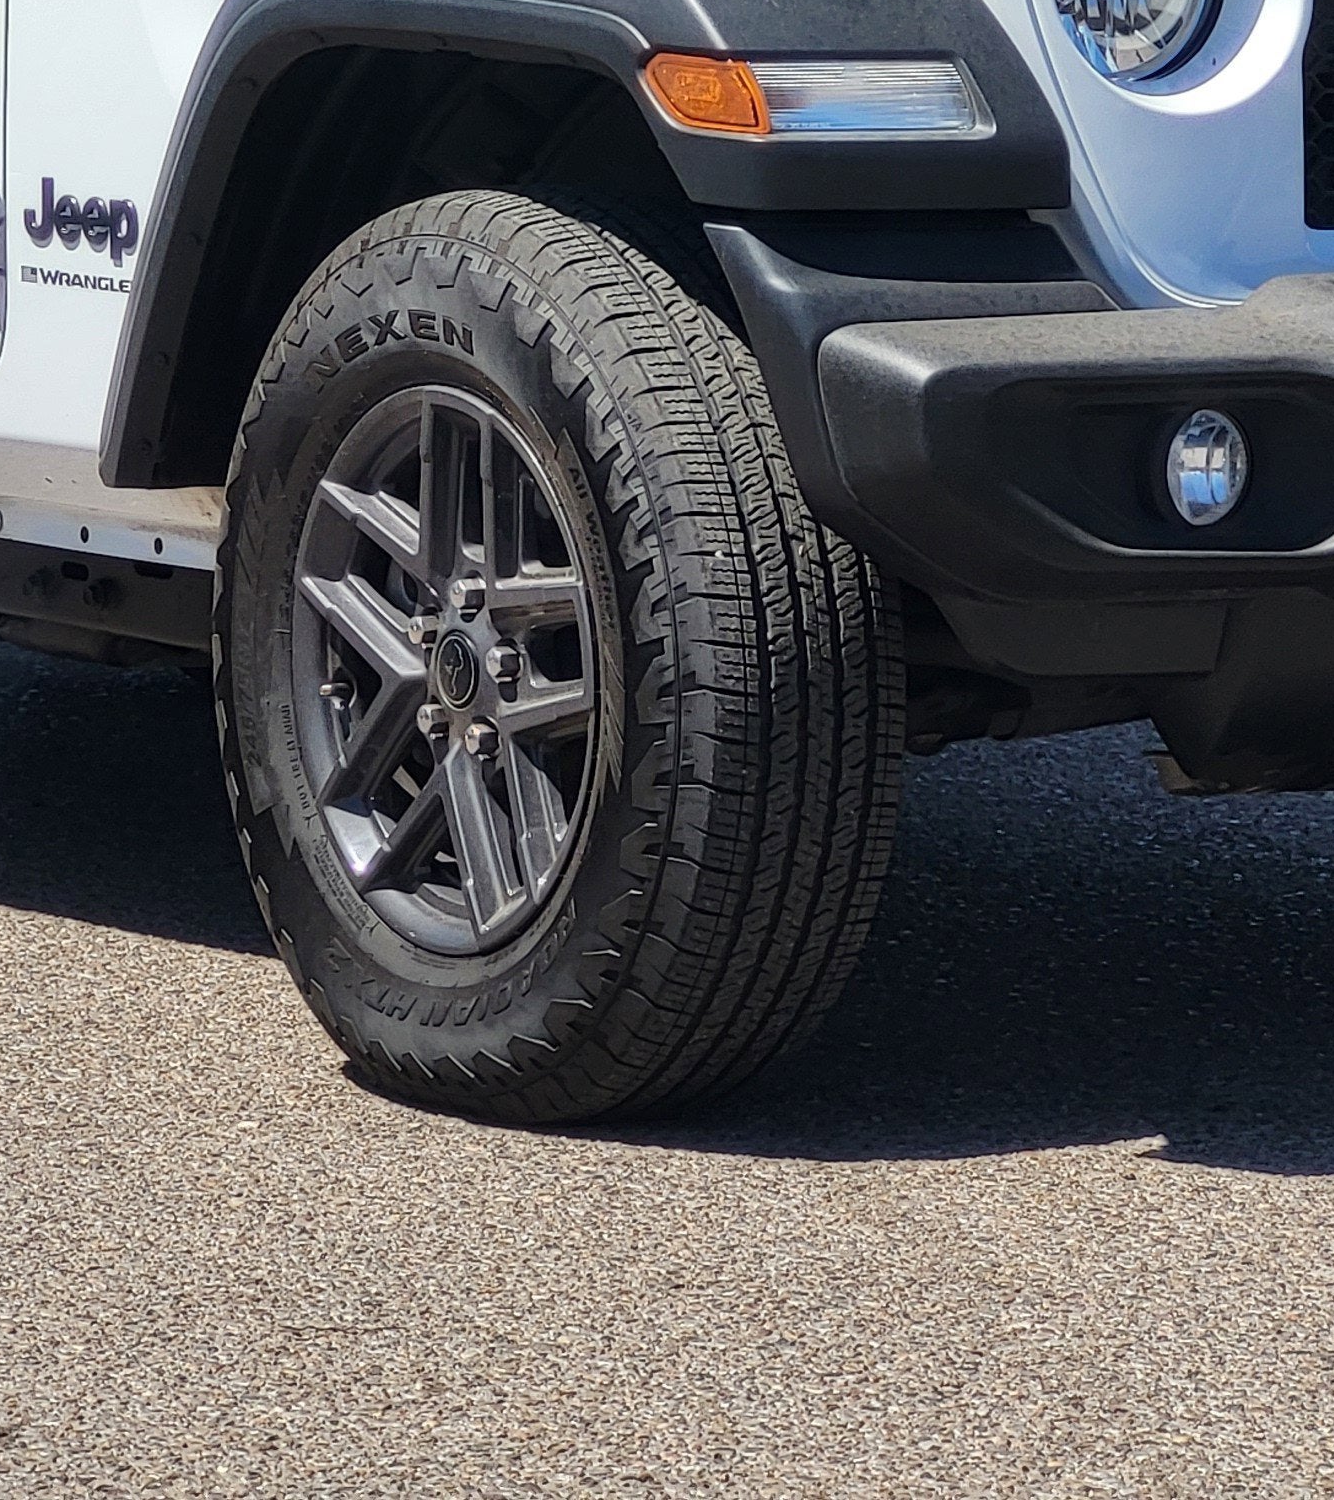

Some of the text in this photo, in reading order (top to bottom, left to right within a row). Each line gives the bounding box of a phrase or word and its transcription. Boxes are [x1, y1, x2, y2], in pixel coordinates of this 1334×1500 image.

[24, 177, 139, 264] Jeep
[40, 268, 131, 293] WRANGLE
[301, 310, 474, 395] NEXEN
